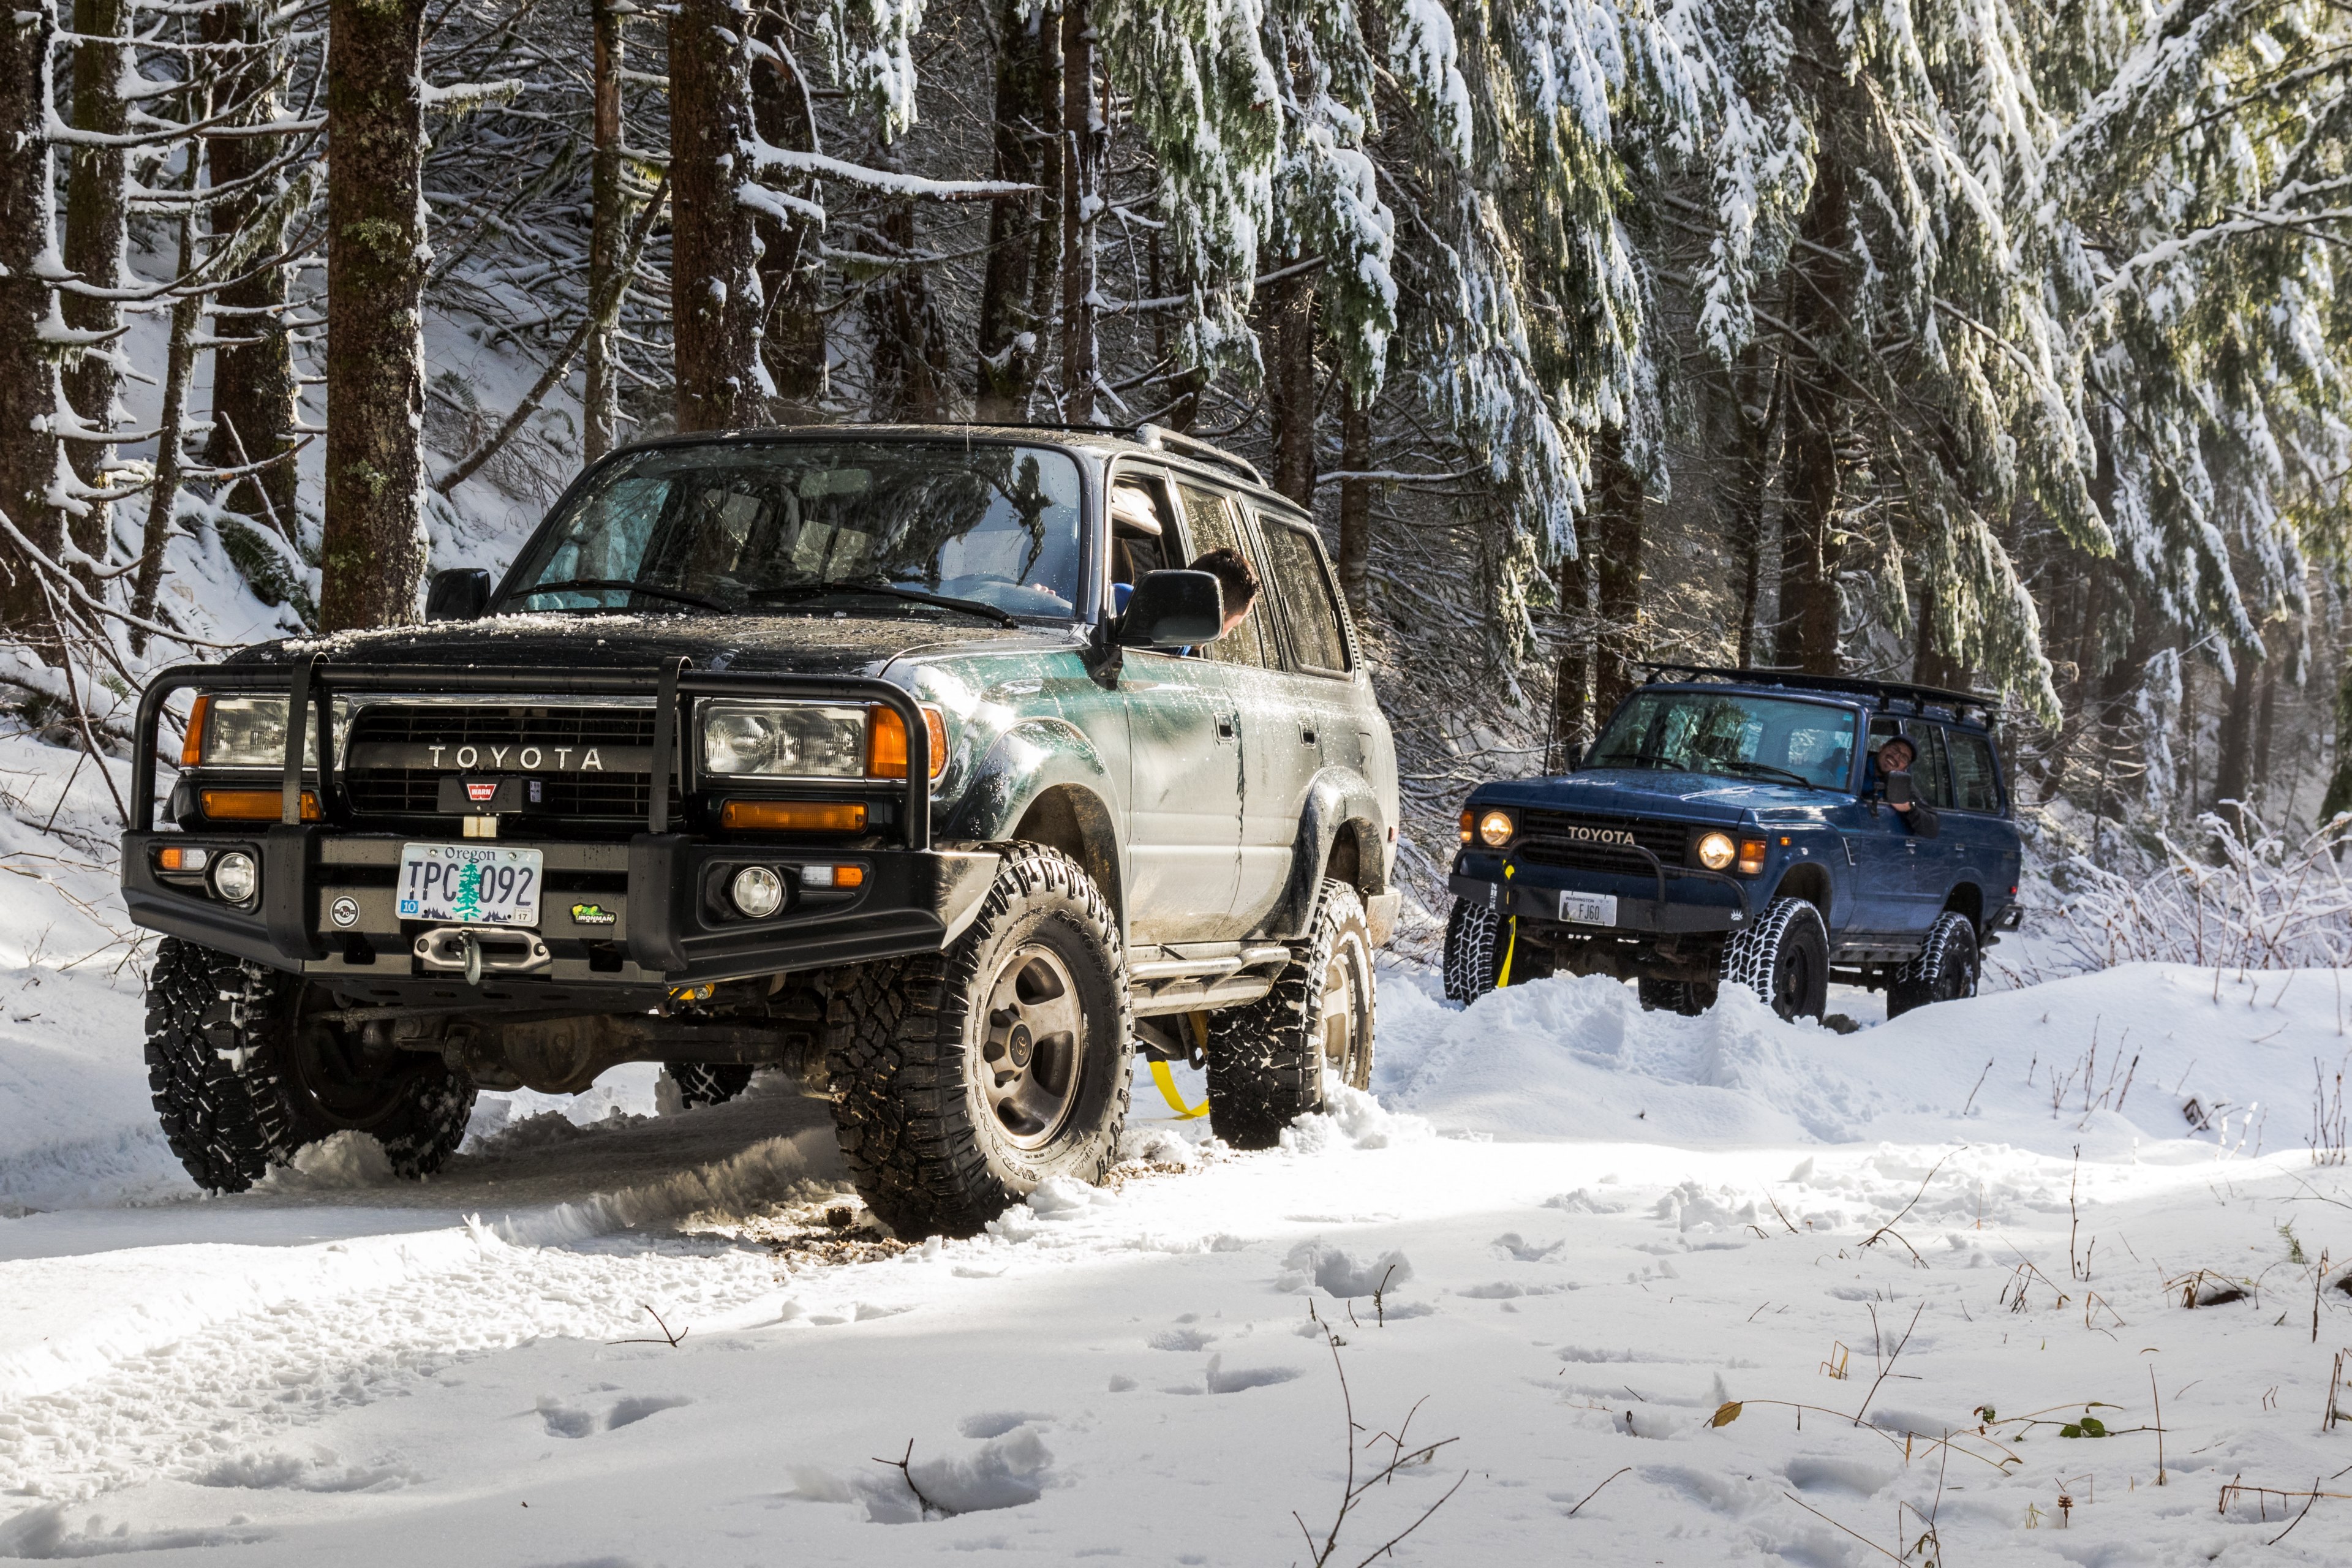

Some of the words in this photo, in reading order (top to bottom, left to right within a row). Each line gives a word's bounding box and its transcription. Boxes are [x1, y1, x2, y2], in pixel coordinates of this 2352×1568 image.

[428, 745, 603, 770] TOYOTA
[1568, 826, 1635, 845] TOYOTA
[445, 847, 497, 863] Oregon
[408, 861, 459, 902] TPC
[478, 865, 533, 906] 092
[403, 901, 416, 912] 10
[1578, 903, 1600, 920] FJ60
